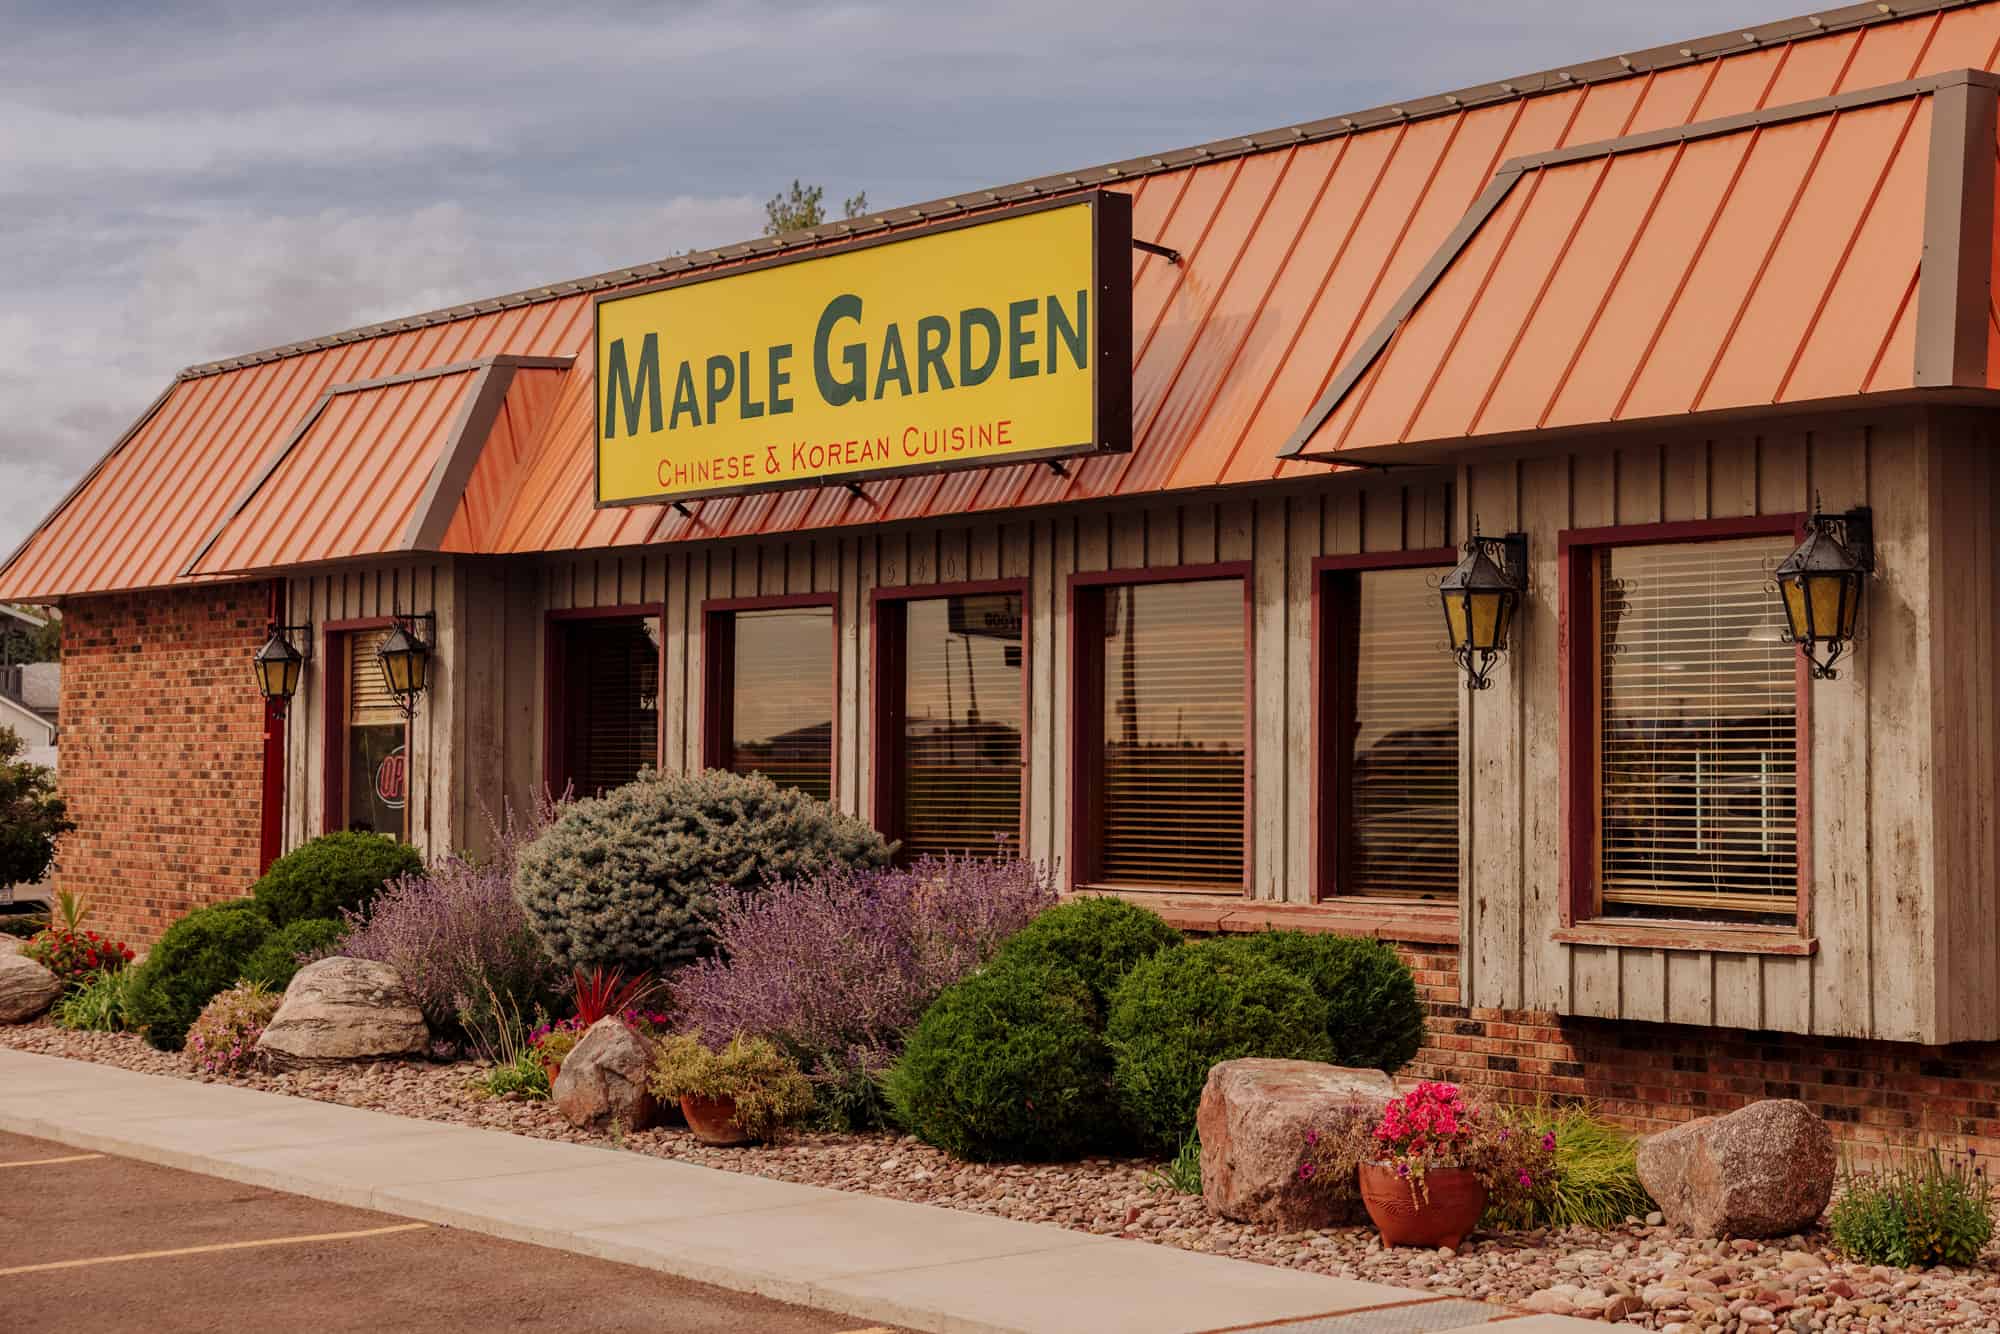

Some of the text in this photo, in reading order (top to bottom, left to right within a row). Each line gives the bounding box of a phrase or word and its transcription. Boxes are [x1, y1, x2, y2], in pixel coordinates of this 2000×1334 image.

[605, 289, 1088, 439] MAPLE GARDEN
[657, 420, 1012, 487] CHINESE & KOREAN CUISINE
